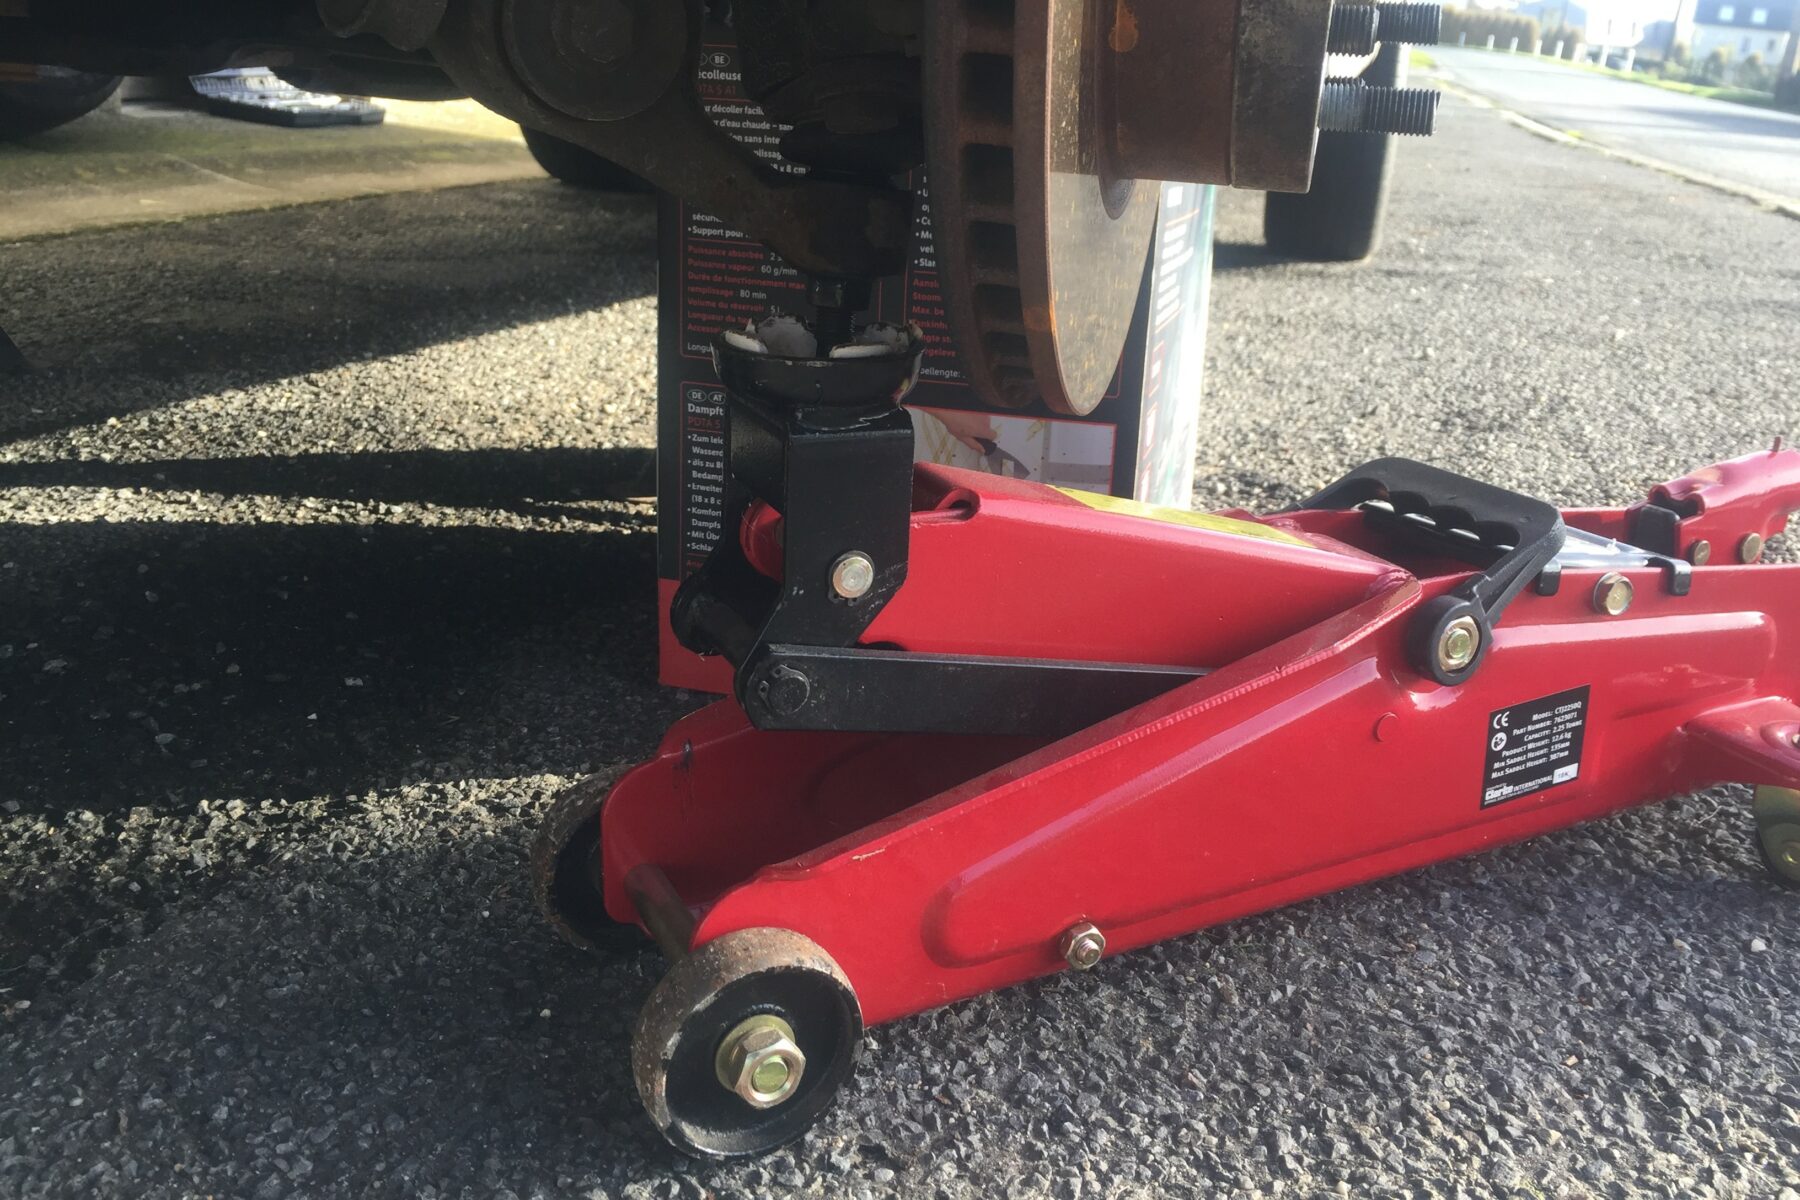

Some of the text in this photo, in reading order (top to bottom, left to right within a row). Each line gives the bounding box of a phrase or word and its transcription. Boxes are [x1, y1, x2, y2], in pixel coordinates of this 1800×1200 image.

[715, 56, 725, 64] BE
[742, 120, 770, 130] chaude
[744, 135, 762, 143] sans
[692, 212, 723, 223] sécuri
[692, 225, 724, 237] Support
[761, 264, 772, 274] 60
[774, 265, 798, 278] g/min
[740, 289, 751, 299] 80
[752, 291, 767, 300] min
[692, 391, 702, 400] DE
[692, 433, 710, 443] Zum
[691, 530, 705, 539] Mit
[1493, 711, 1510, 729] CE
